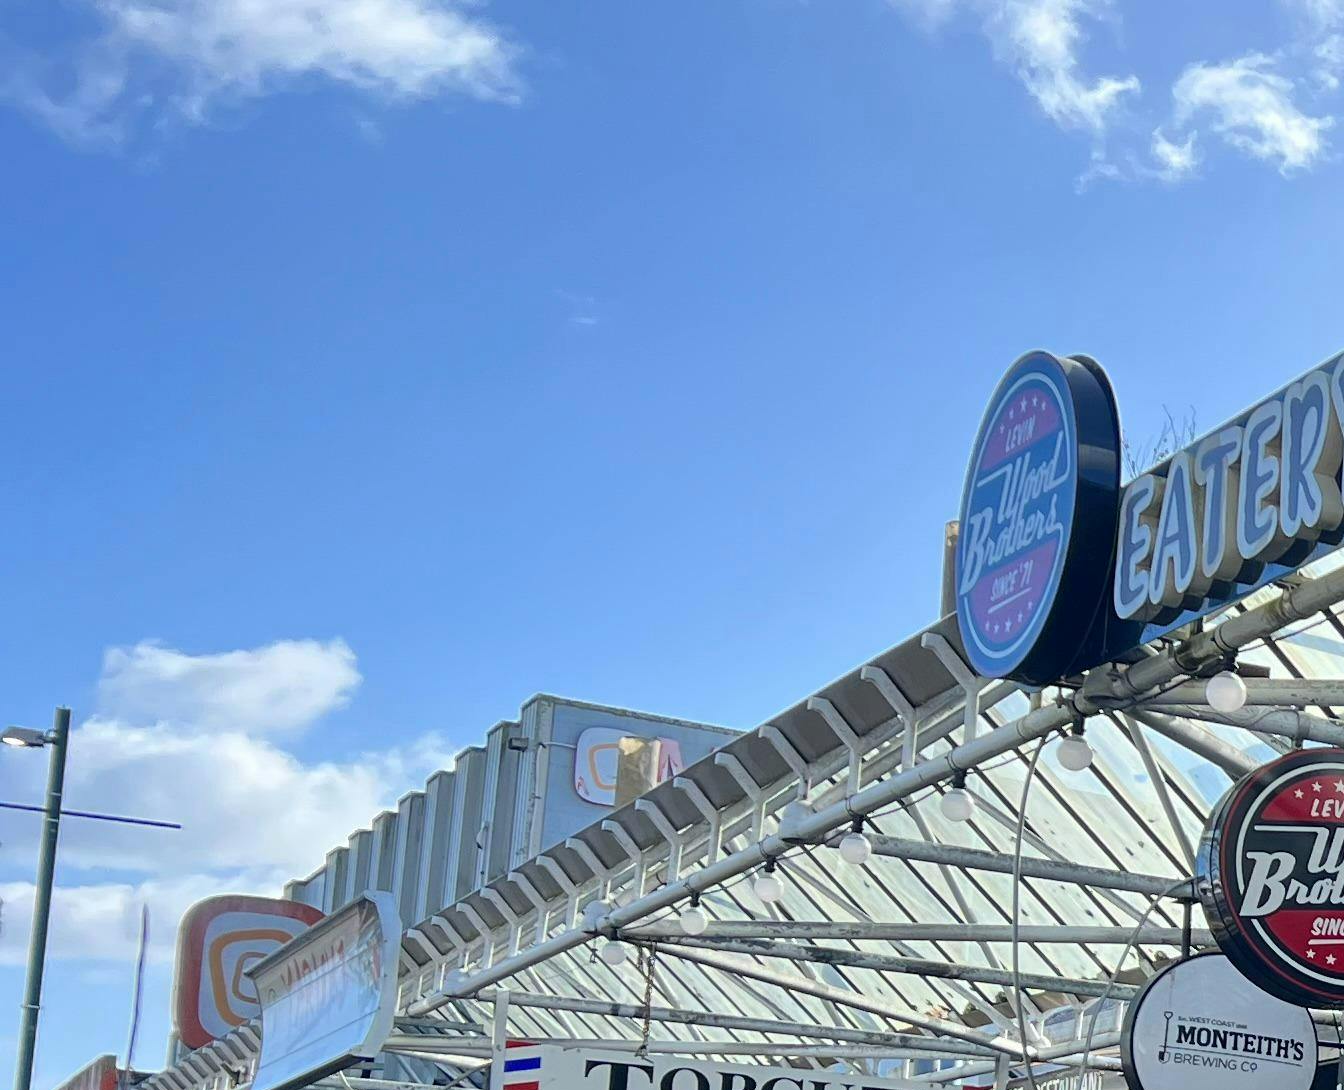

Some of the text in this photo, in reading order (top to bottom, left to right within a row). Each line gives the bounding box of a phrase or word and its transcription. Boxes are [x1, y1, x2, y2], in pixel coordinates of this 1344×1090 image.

[1005, 415, 1037, 453] LEVIN
[990, 430, 1065, 525] Wood
[959, 493, 1064, 595] Brothers
[990, 574, 1018, 602] SINCE
[1176, 1024, 1304, 1061] MONTEITH'S
[1174, 1052, 1237, 1071] BREWING
